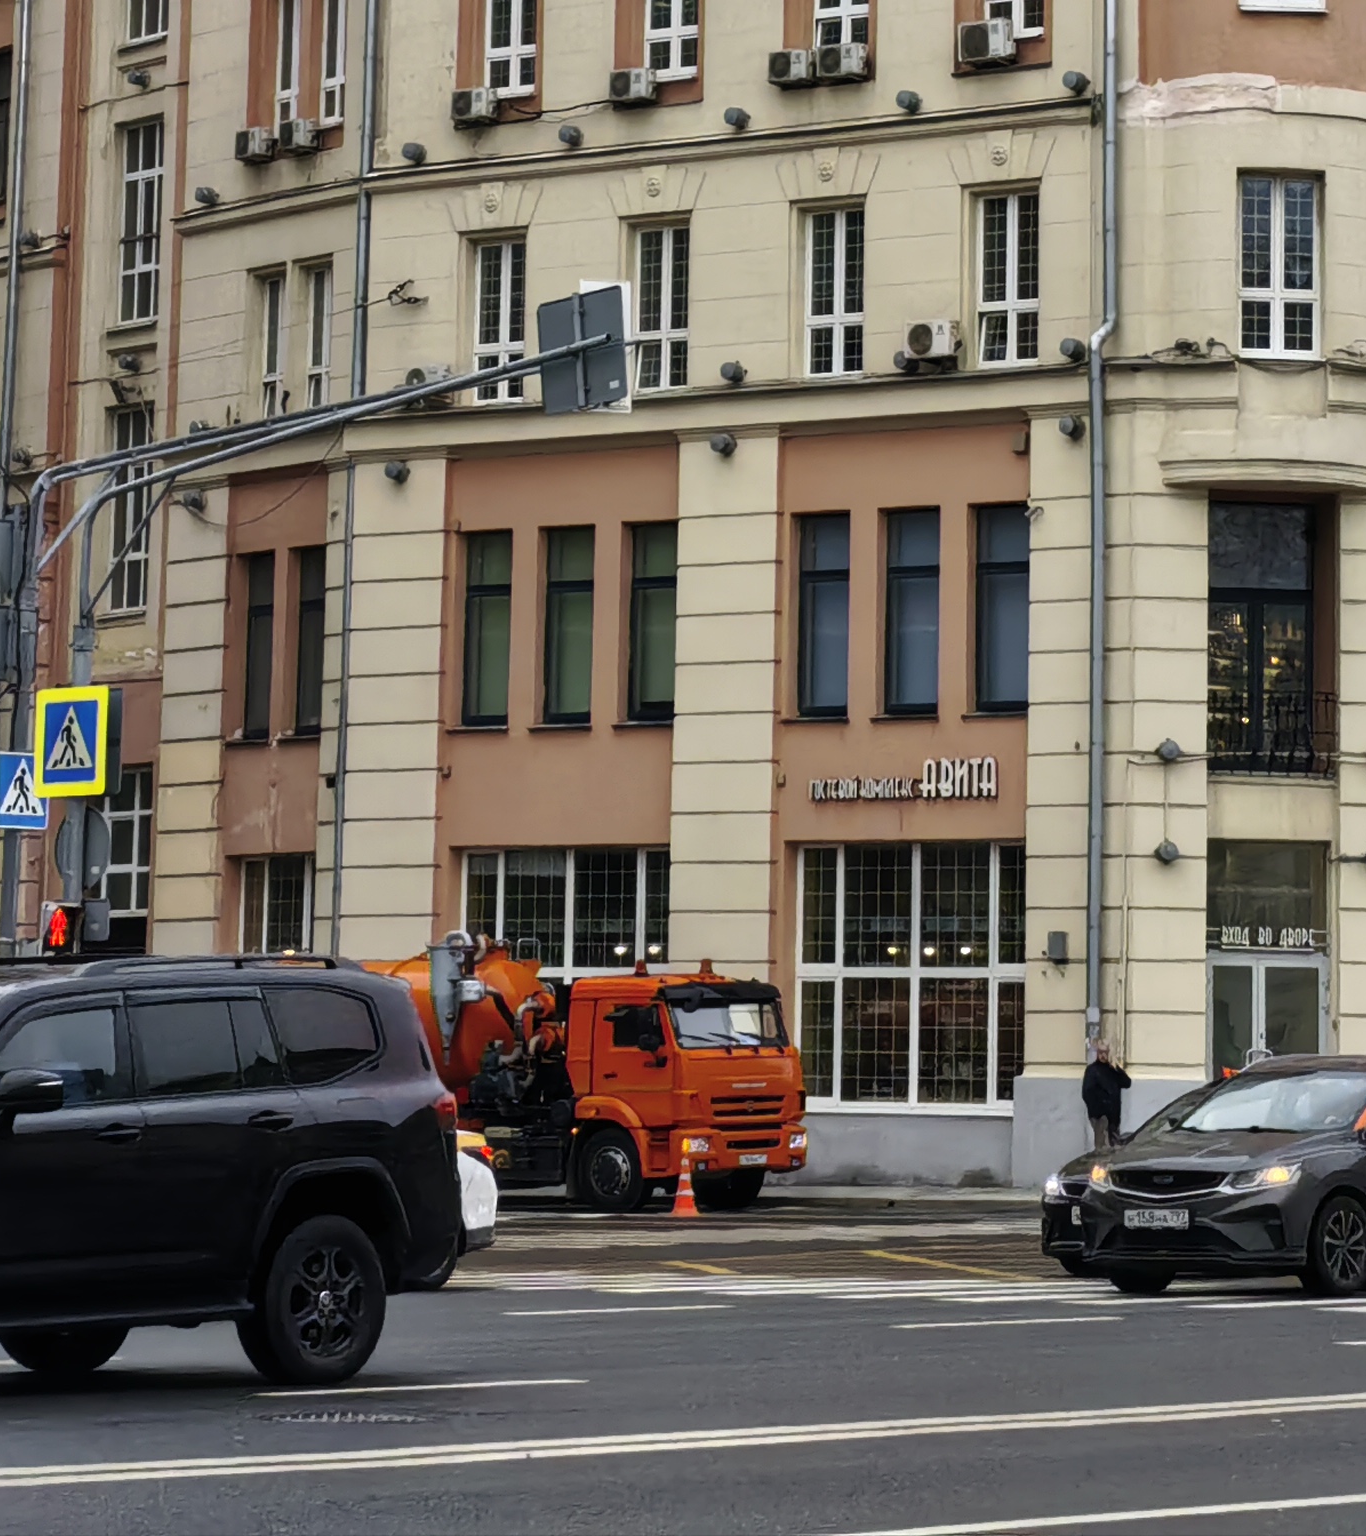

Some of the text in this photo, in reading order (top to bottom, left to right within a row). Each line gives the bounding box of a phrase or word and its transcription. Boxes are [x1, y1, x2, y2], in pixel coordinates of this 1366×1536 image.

[919, 756, 997, 798] АВИТА
[1221, 925, 1250, 947] ВХОД
[1258, 926, 1273, 946] ВО
